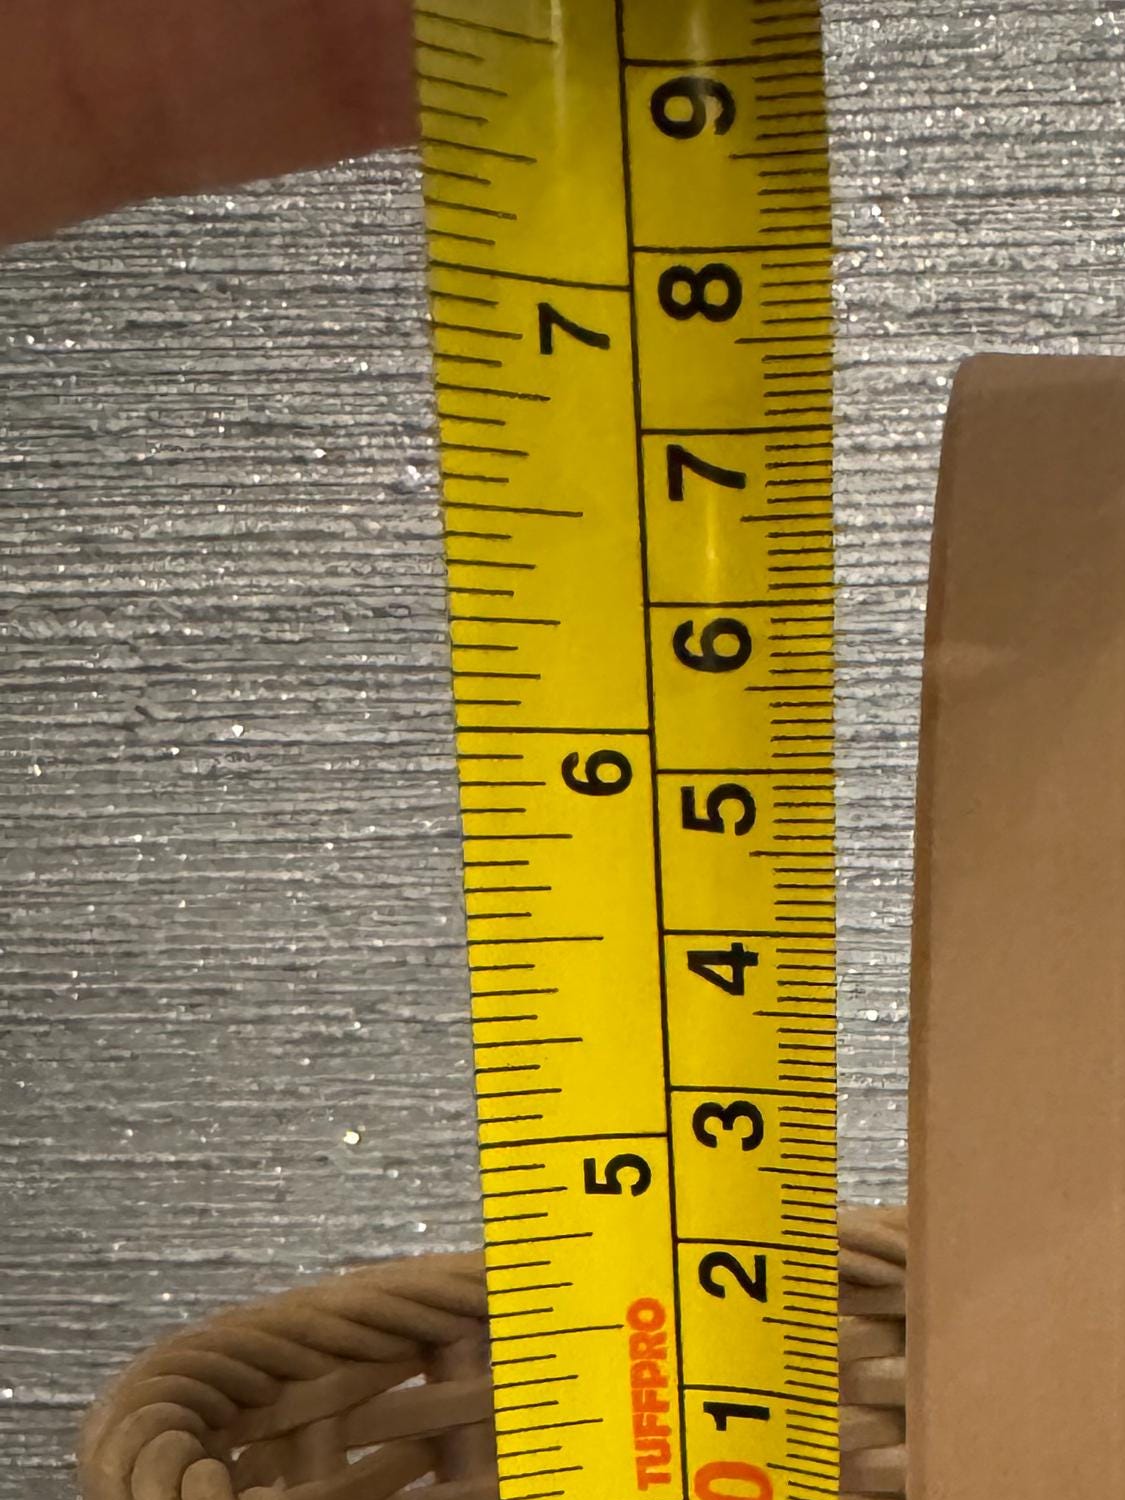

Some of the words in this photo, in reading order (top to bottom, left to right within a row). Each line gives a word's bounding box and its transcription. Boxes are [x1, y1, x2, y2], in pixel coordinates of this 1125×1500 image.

[650, 76, 736, 139] 9
[658, 263, 742, 322] 8
[538, 302, 610, 355] 7
[666, 444, 747, 501] 7
[672, 618, 752, 673] 6
[561, 749, 632, 797] 6
[680, 783, 756, 836] 5
[687, 942, 759, 996] 4
[692, 1100, 764, 1151] 3
[583, 1153, 651, 1197] 5
[698, 1251, 767, 1303] 2
[626, 1297, 672, 1491] TUFFPRO
[703, 1401, 770, 1431] 1
